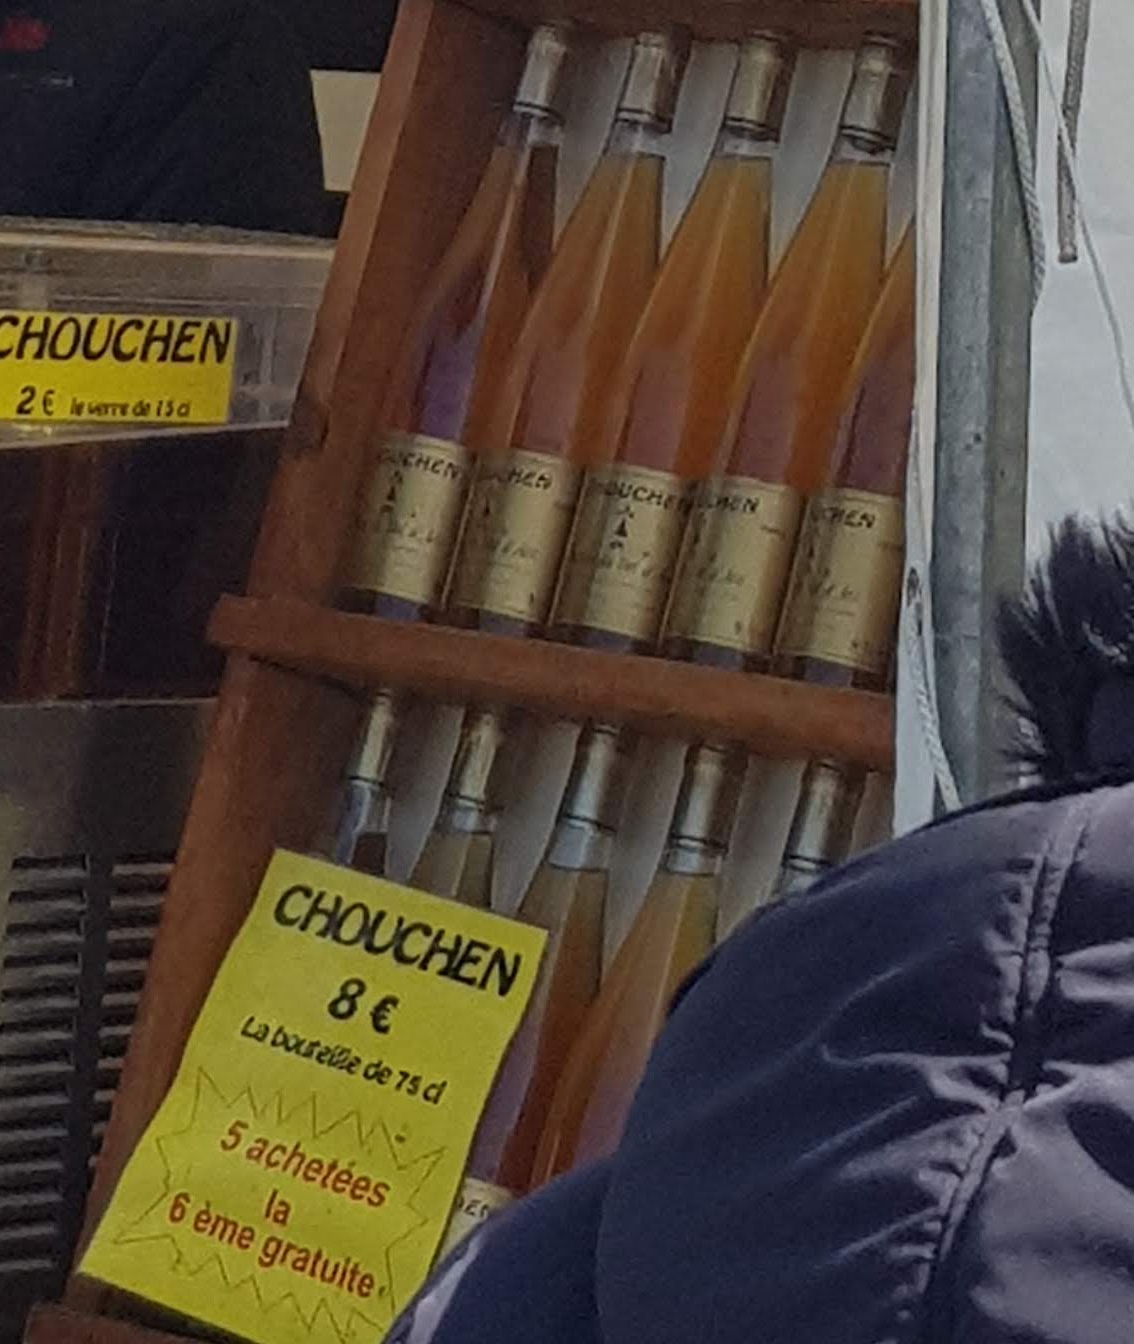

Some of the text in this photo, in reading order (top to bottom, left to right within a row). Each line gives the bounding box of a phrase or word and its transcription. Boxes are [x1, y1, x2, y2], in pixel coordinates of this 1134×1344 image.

[16, 385, 37, 415] 2
[42, 389, 56, 416] €
[132, 399, 151, 417] de
[273, 884, 522, 997] CHOUCHEN
[327, 977, 400, 1035] 8 €
[240, 1015, 448, 1105] La bouteille de 75 cl
[220, 1120, 391, 1207] 5 achetées
[264, 1188, 292, 1226] la
[168, 1192, 376, 1298] 6 ème gratuite
